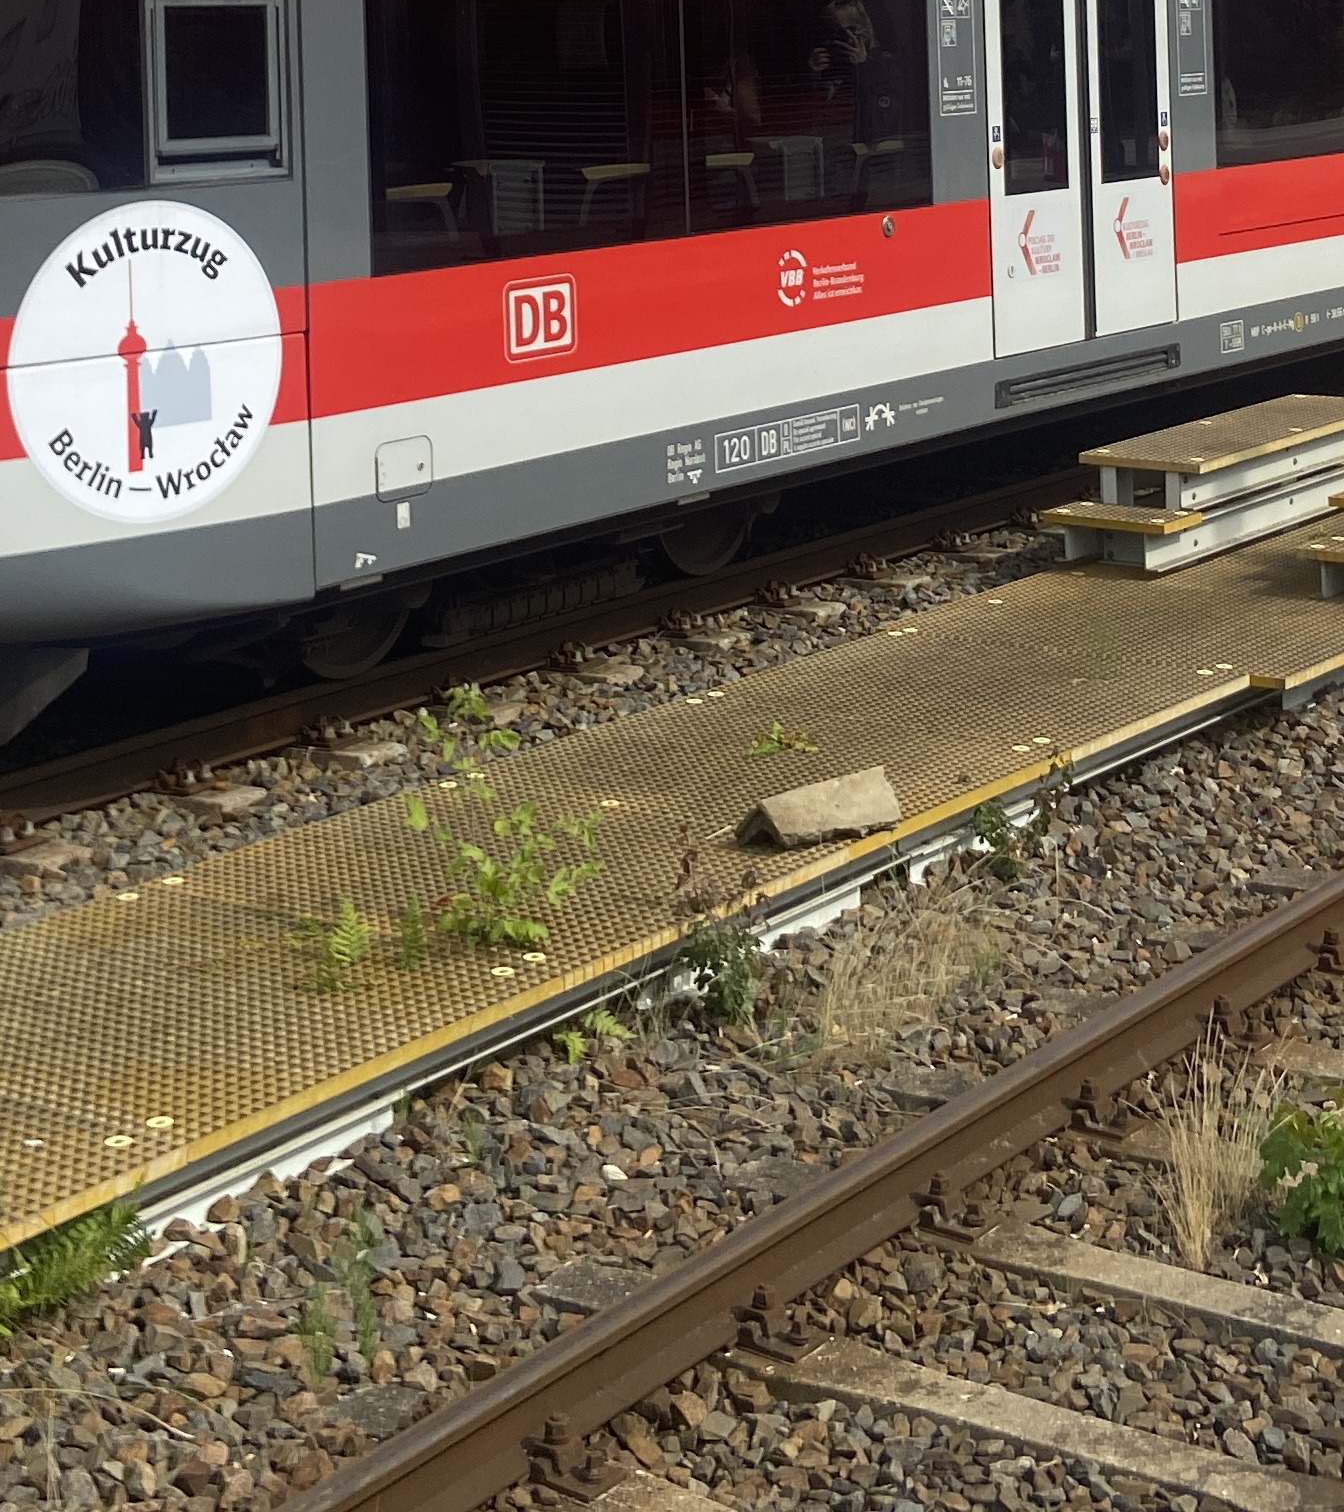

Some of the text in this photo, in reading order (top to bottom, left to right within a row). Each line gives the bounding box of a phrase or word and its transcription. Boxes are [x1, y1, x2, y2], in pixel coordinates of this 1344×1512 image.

[65, 226, 228, 288] Kulturzug
[780, 268, 804, 288] VBB
[514, 289, 568, 348] DB
[48, 428, 123, 499] Berlin
[156, 402, 255, 500] Wrocław
[723, 435, 750, 464] 120
[760, 429, 777, 456] DB
